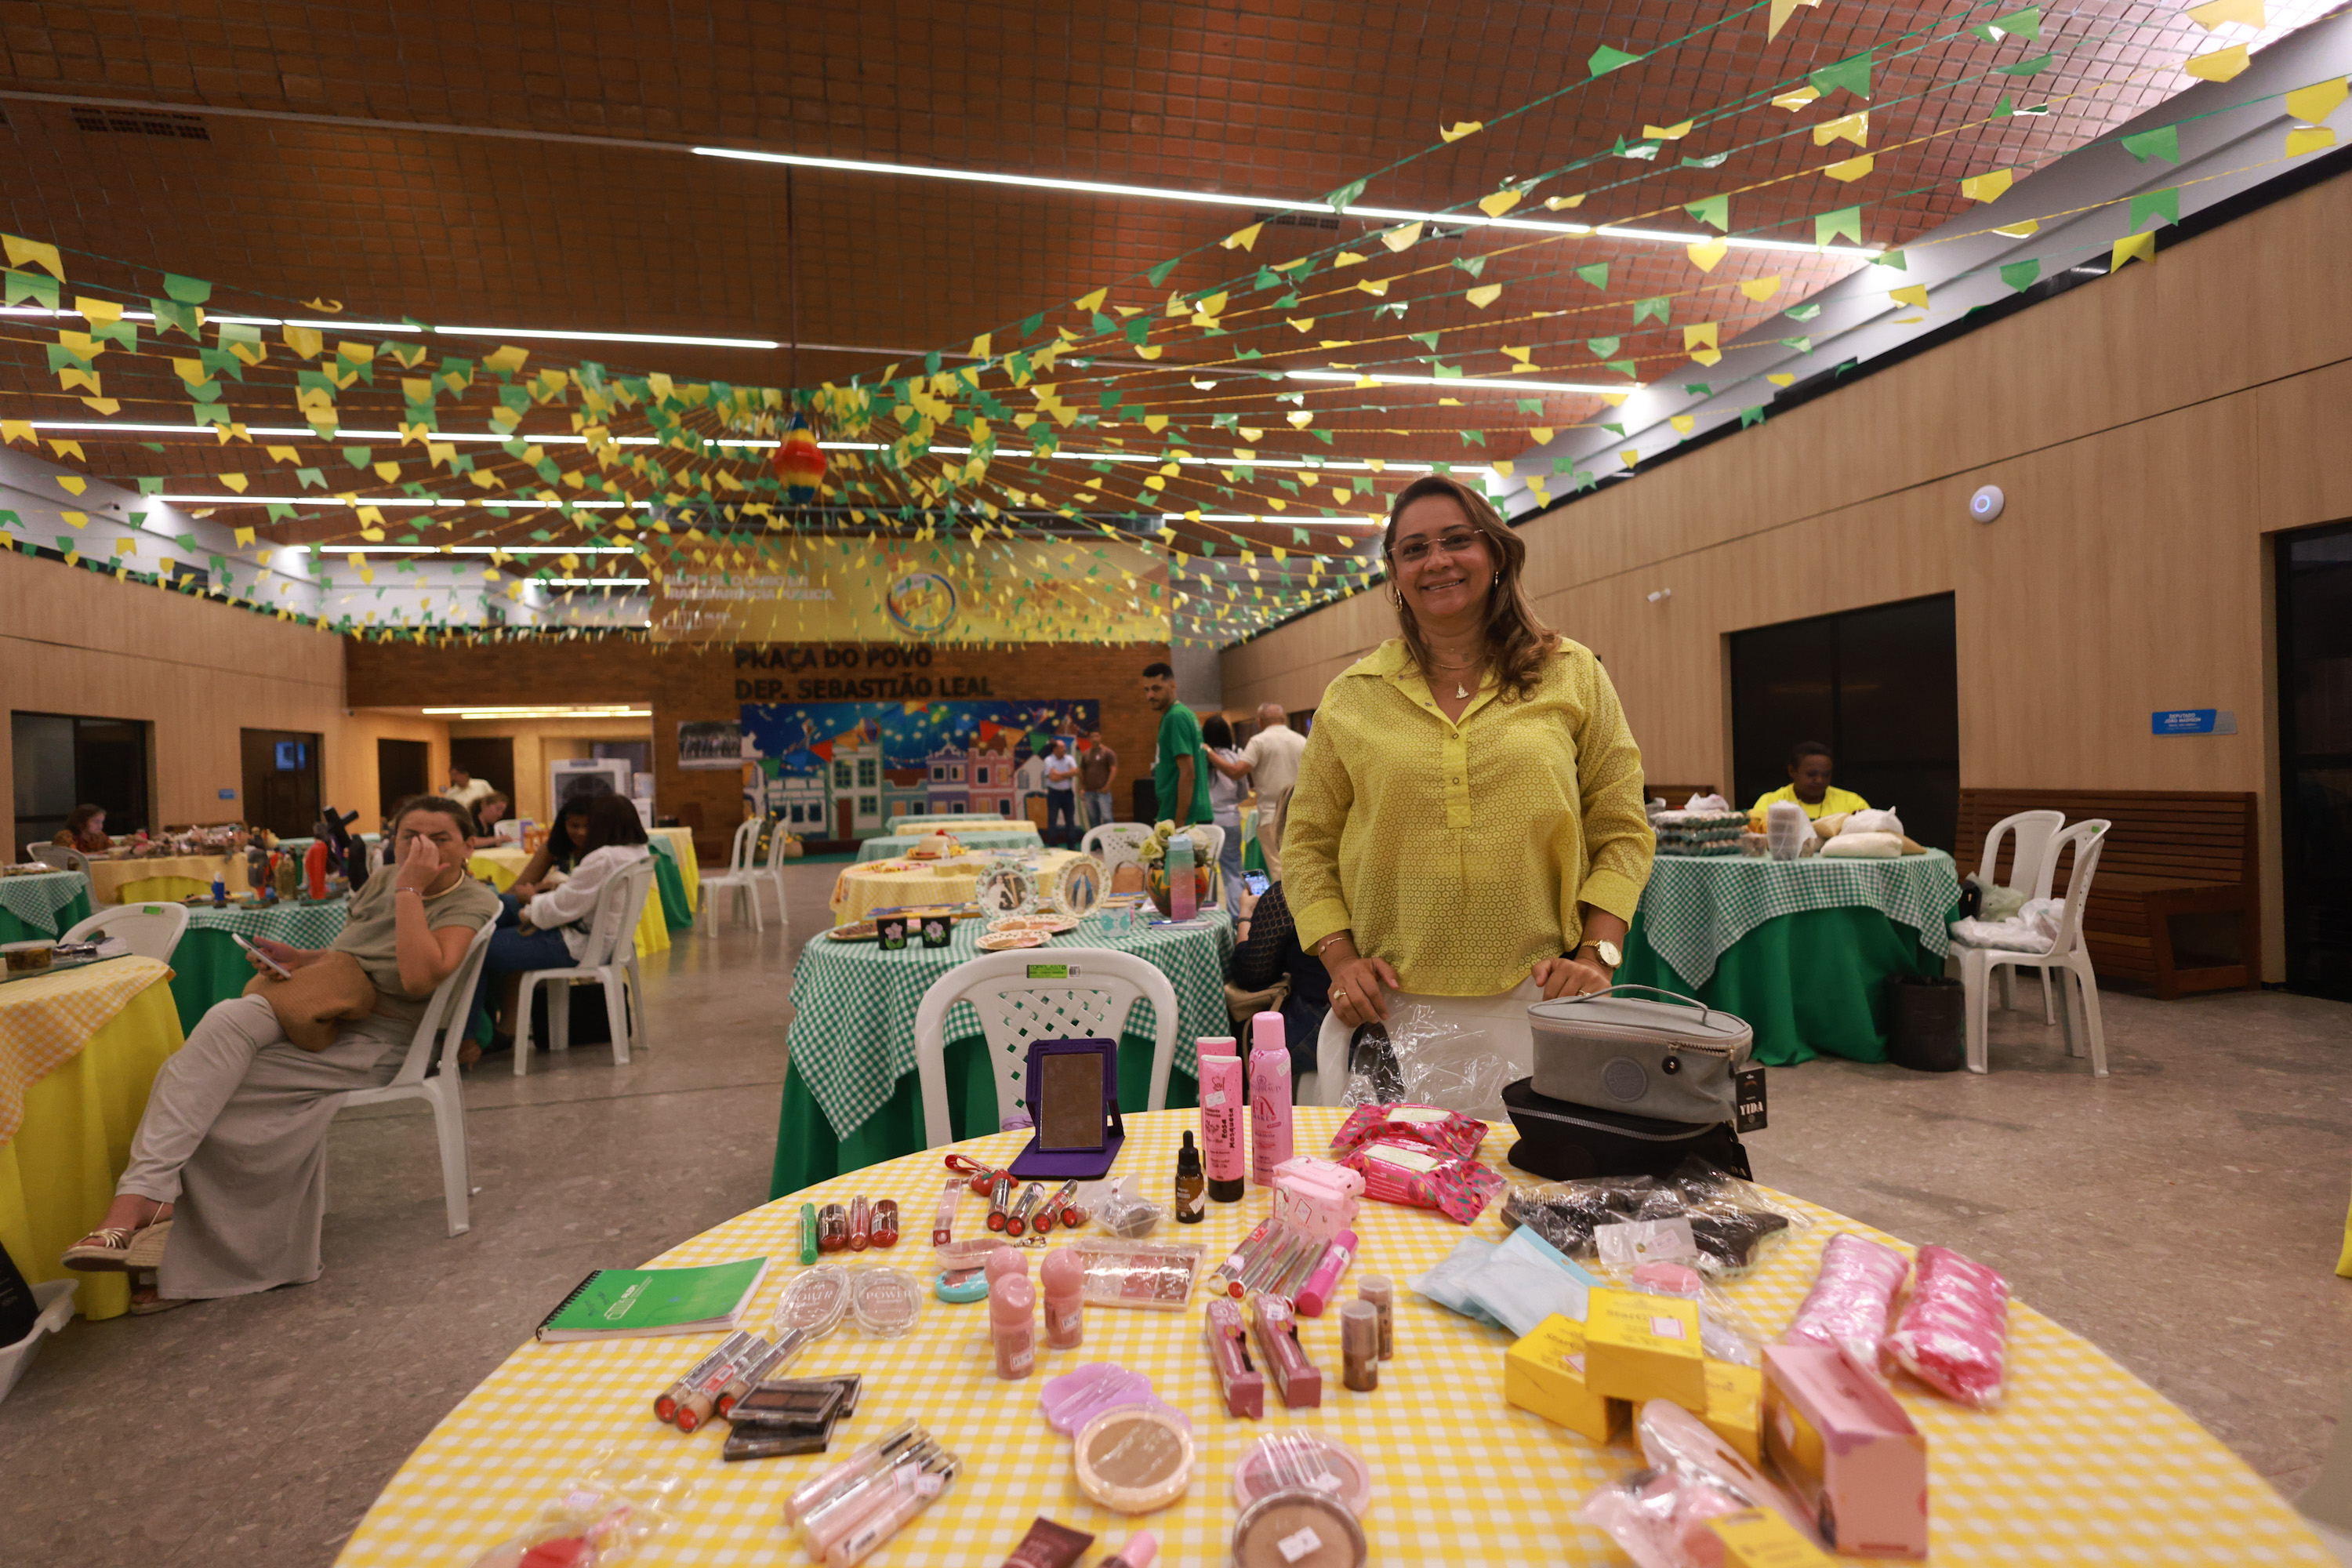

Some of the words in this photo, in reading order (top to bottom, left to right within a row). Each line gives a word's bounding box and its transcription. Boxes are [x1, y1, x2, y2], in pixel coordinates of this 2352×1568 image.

[735, 648, 818, 673] PRAÇA
[824, 648, 859, 667] DO
[867, 648, 933, 667] POVO
[735, 678, 789, 699] DEP.
[797, 673, 933, 699] SEBASTIÃO
[940, 677, 994, 697] LEAL
[1740, 1101, 1764, 1116] YIDA
